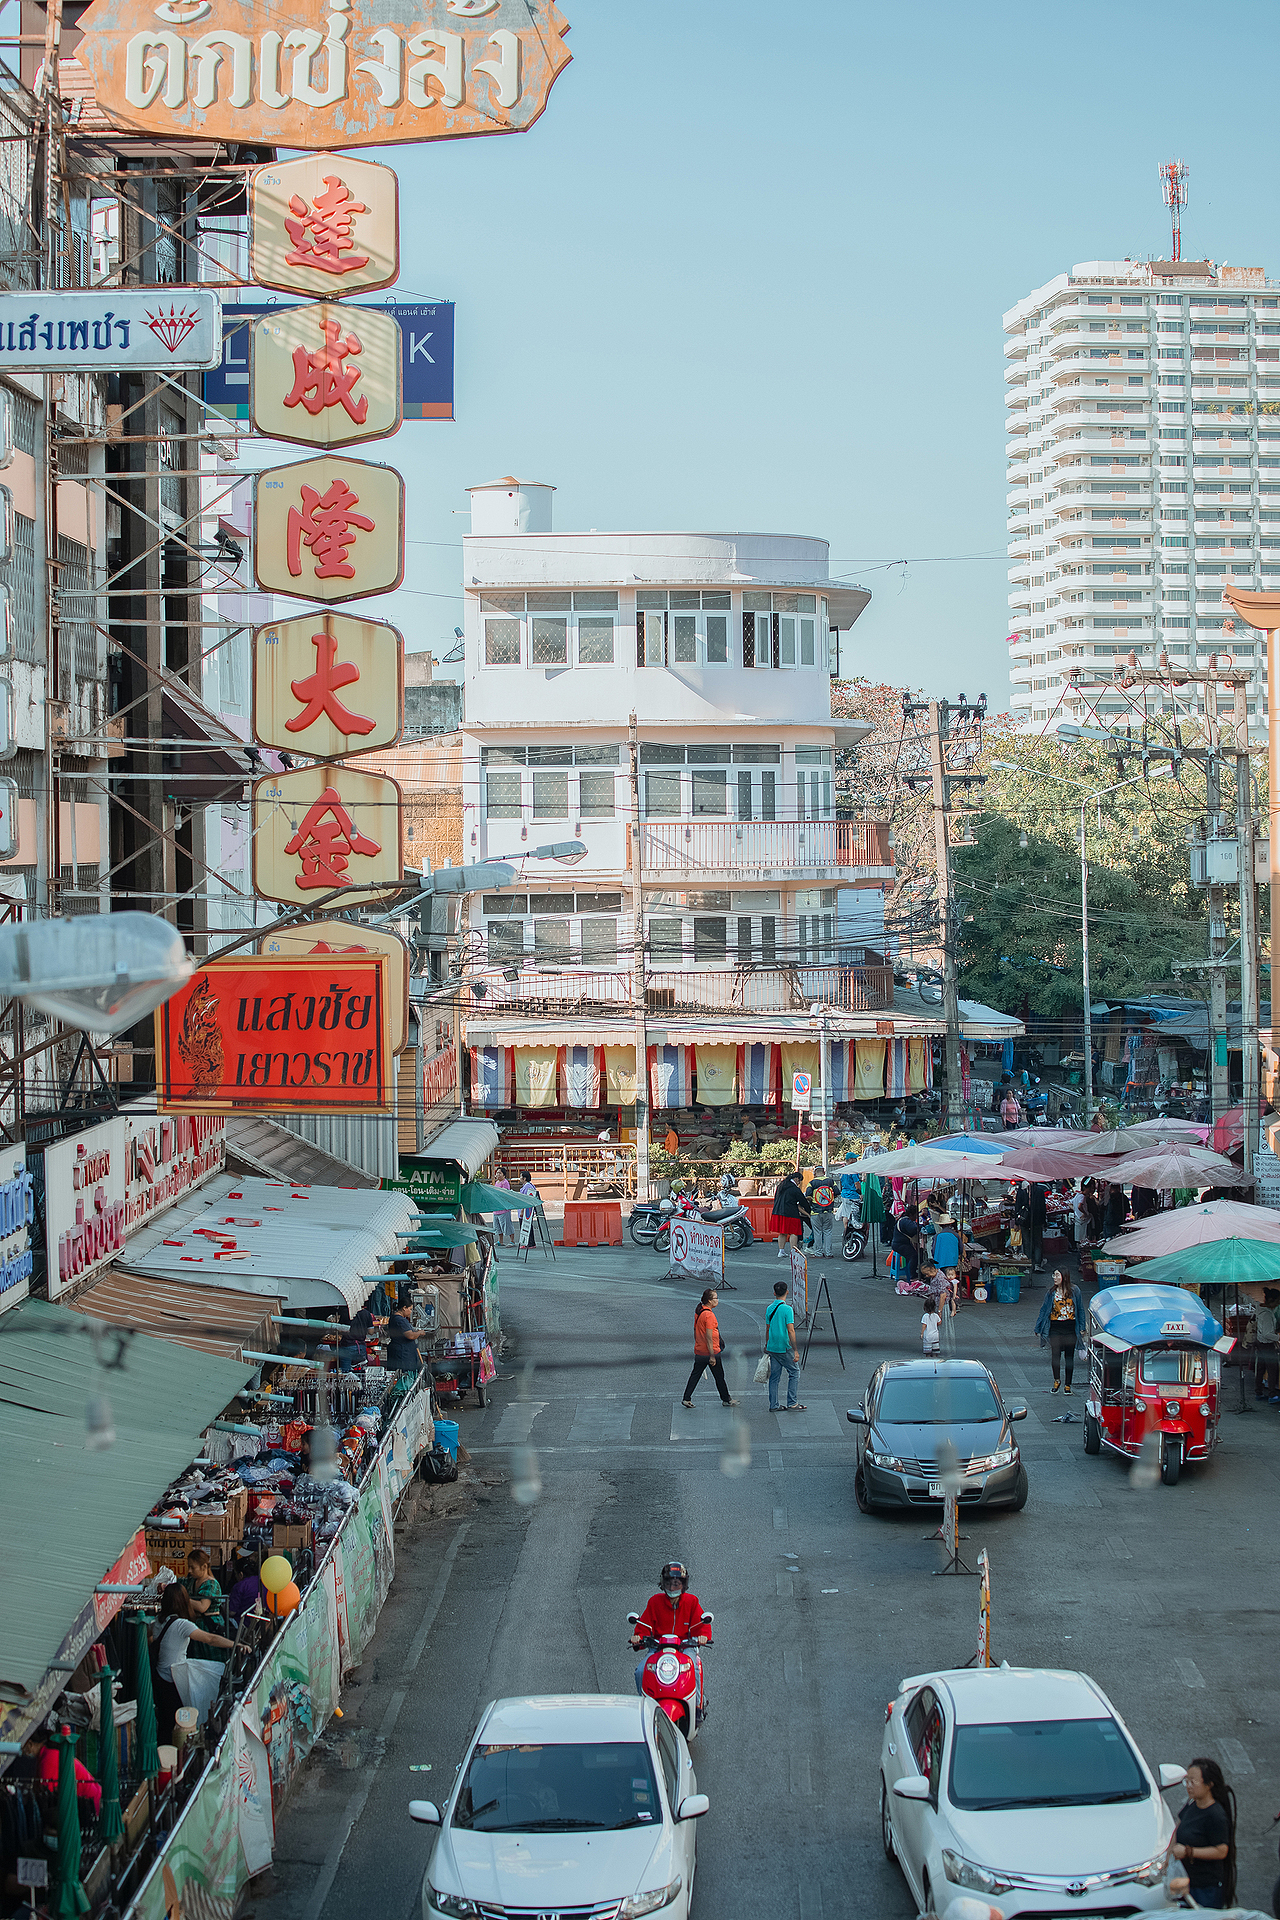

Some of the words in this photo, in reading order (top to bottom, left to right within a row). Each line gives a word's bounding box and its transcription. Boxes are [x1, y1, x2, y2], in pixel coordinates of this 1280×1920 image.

[284, 632, 377, 736] 大
[1220, 852, 1233, 860] 160
[236, 983, 374, 1032] แสงชัย
[235, 1048, 375, 1087] เยาวราช
[409, 1170, 445, 1184] ATM
[689, 1225, 721, 1249] ห้ามจอด
[1166, 1323, 1184, 1331] TAXI
